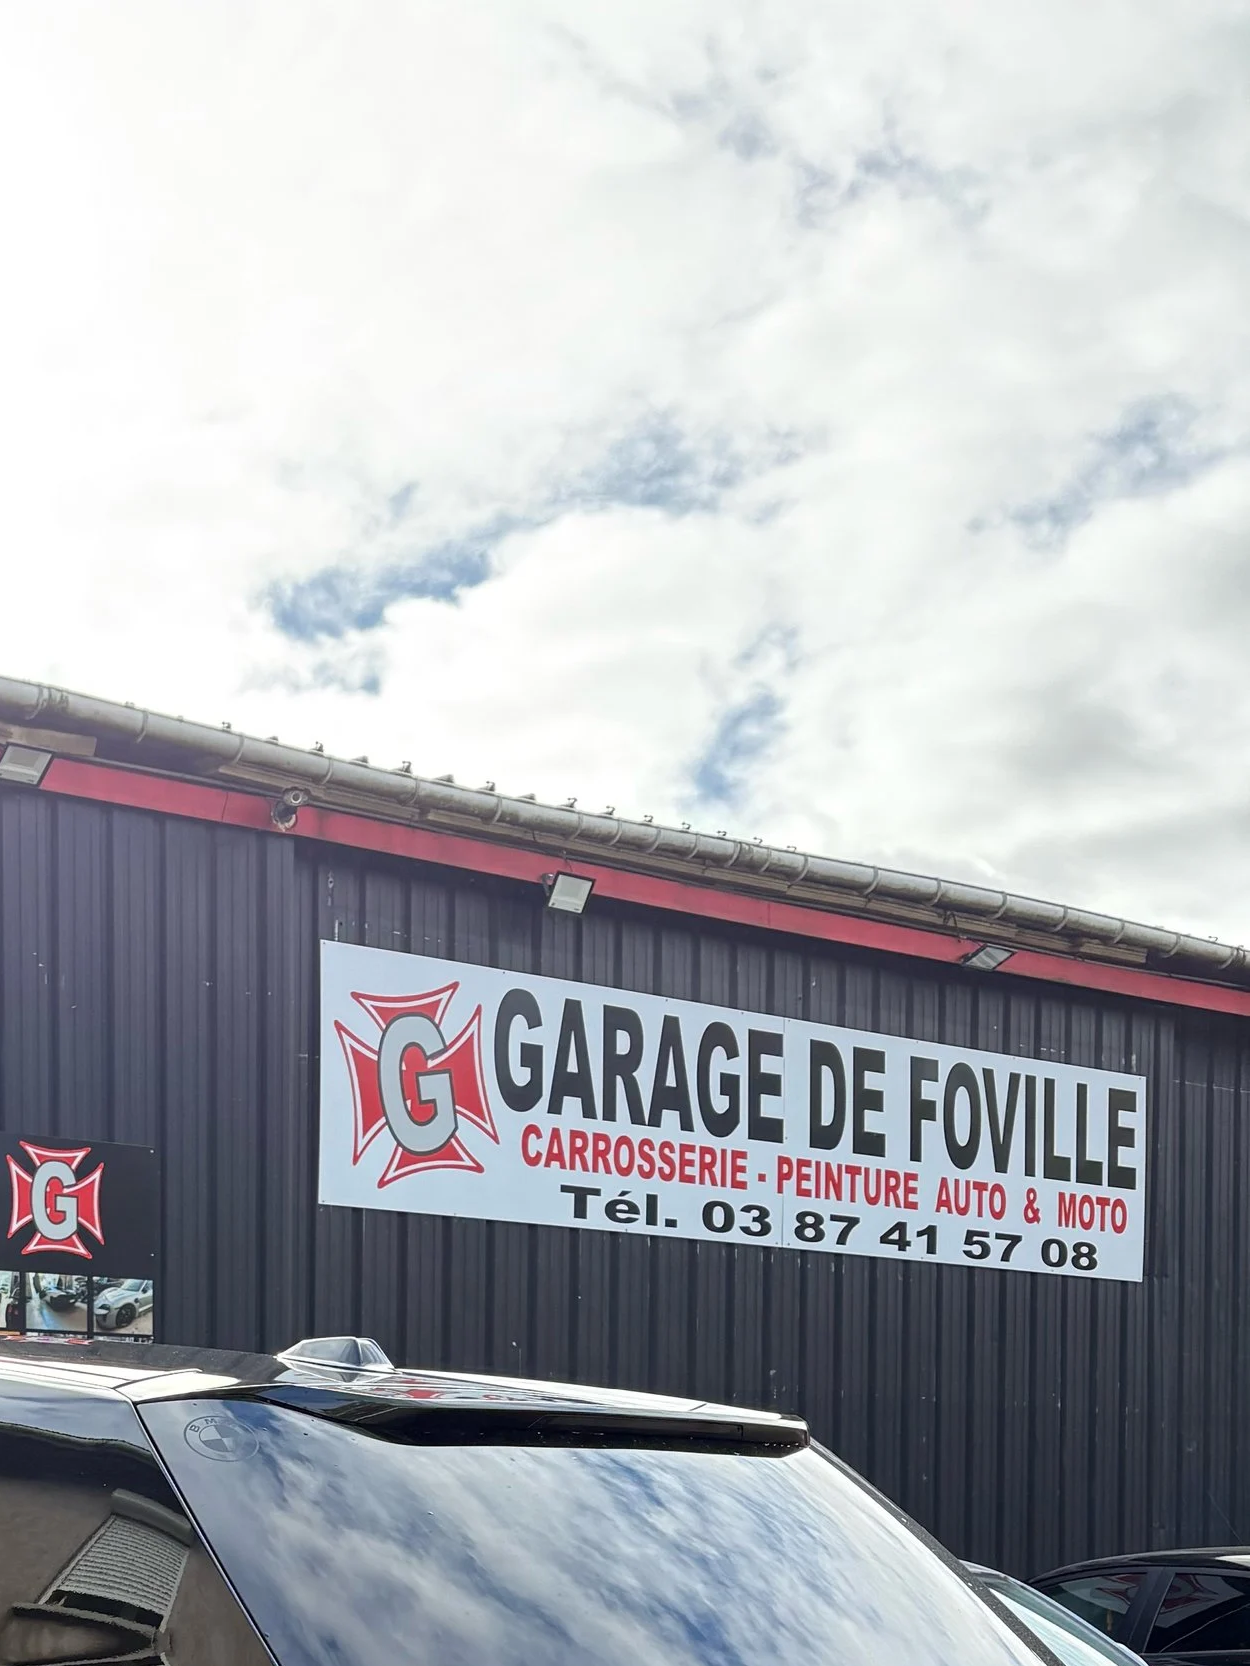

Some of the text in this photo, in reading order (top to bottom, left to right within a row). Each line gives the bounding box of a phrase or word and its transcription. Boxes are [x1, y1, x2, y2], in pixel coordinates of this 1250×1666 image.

[378, 1011, 458, 1156] G
[493, 987, 1139, 1191] GARAGE DE FOVILLE
[30, 1159, 80, 1242] G
[520, 1123, 749, 1191] CARROSSERIE
[776, 1154, 920, 1210] PEINTURE
[934, 1176, 1007, 1220] AUTO
[1023, 1187, 1041, 1225] &
[1056, 1191, 1128, 1235] MOTO
[560, 1183, 1099, 1272] Tél. 03 87 41 57 08
